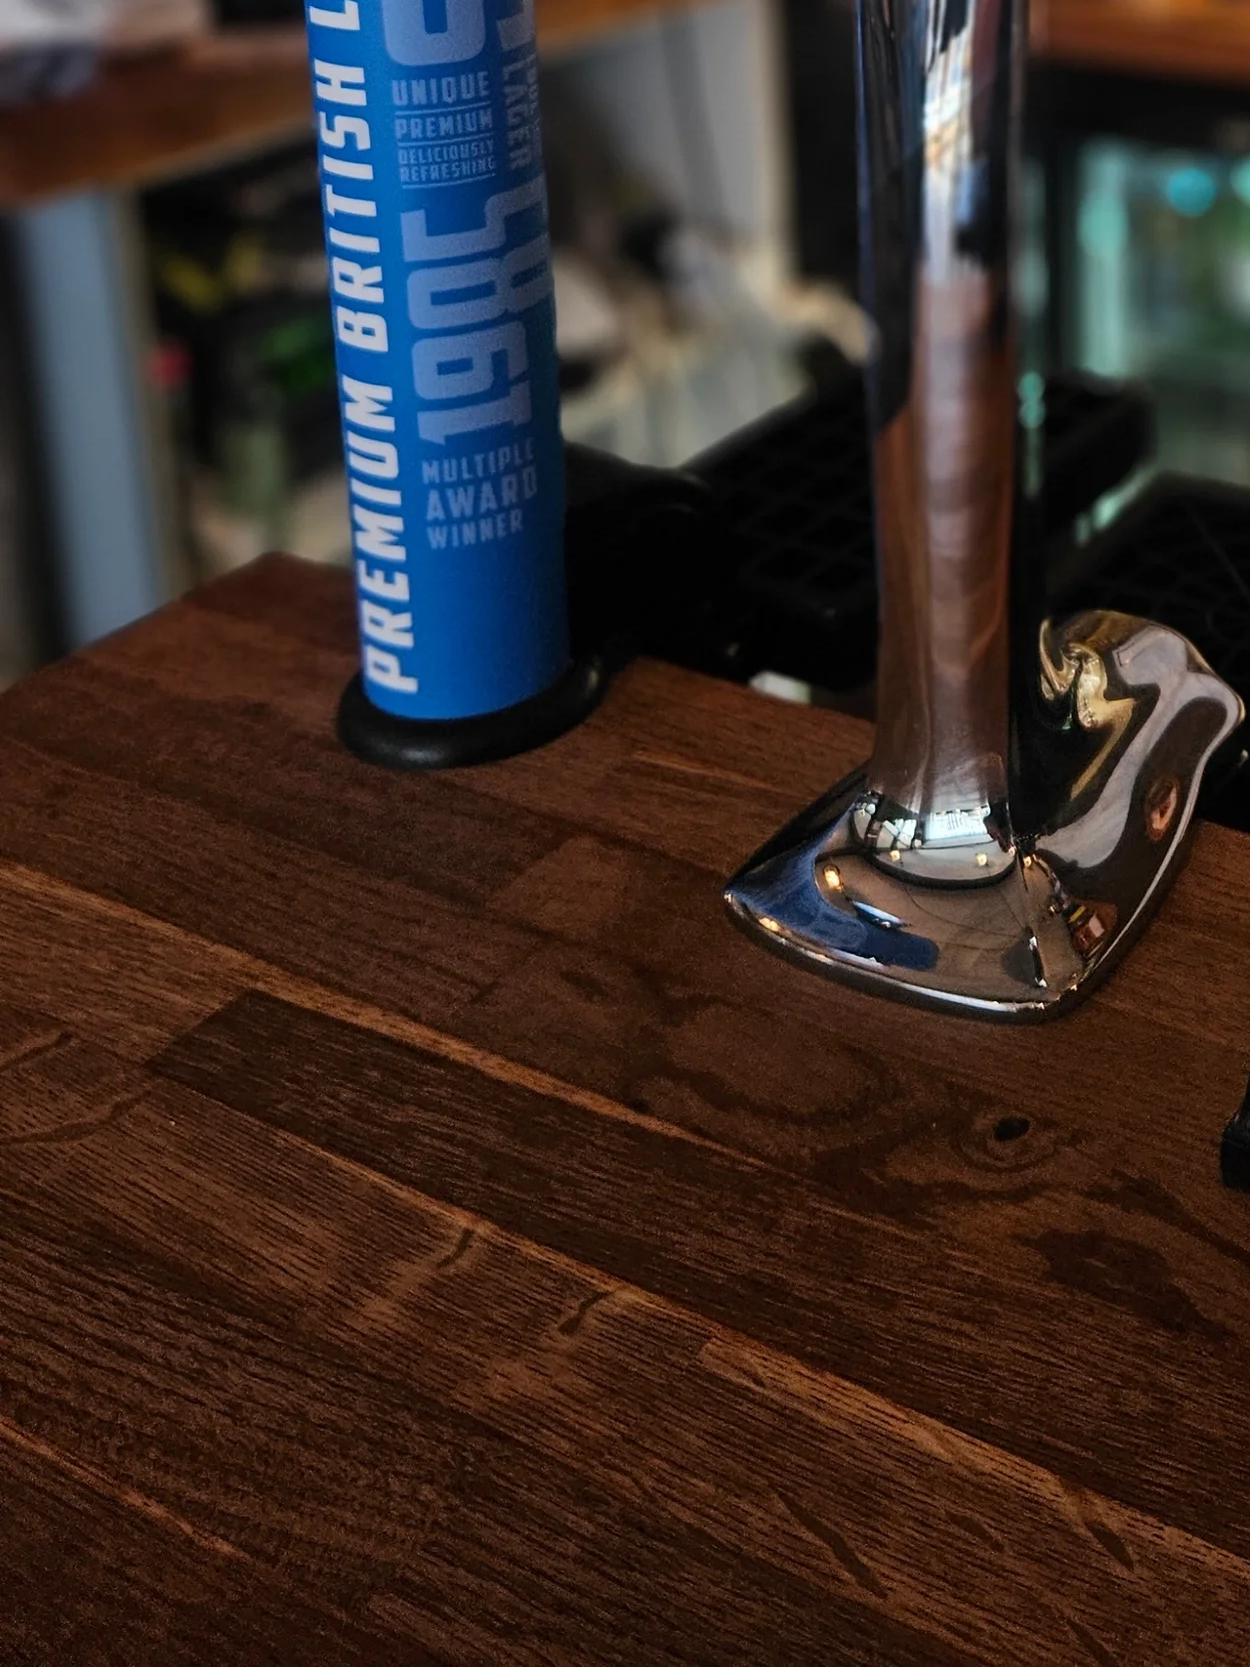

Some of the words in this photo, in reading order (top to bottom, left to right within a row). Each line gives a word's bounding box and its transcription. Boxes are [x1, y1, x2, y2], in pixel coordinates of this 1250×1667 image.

[392, 71, 490, 106] UNIQUE
[395, 108, 492, 140] PREMIUM
[398, 138, 494, 165] DELICIOUSLY
[399, 155, 496, 182] REFRESHING
[313, 58, 389, 353] BRITISH
[422, 438, 534, 483] MULTIPLE
[426, 464, 537, 521] AWARD
[342, 375, 418, 694] PREMIUM
[427, 513, 524, 550] WINNER
